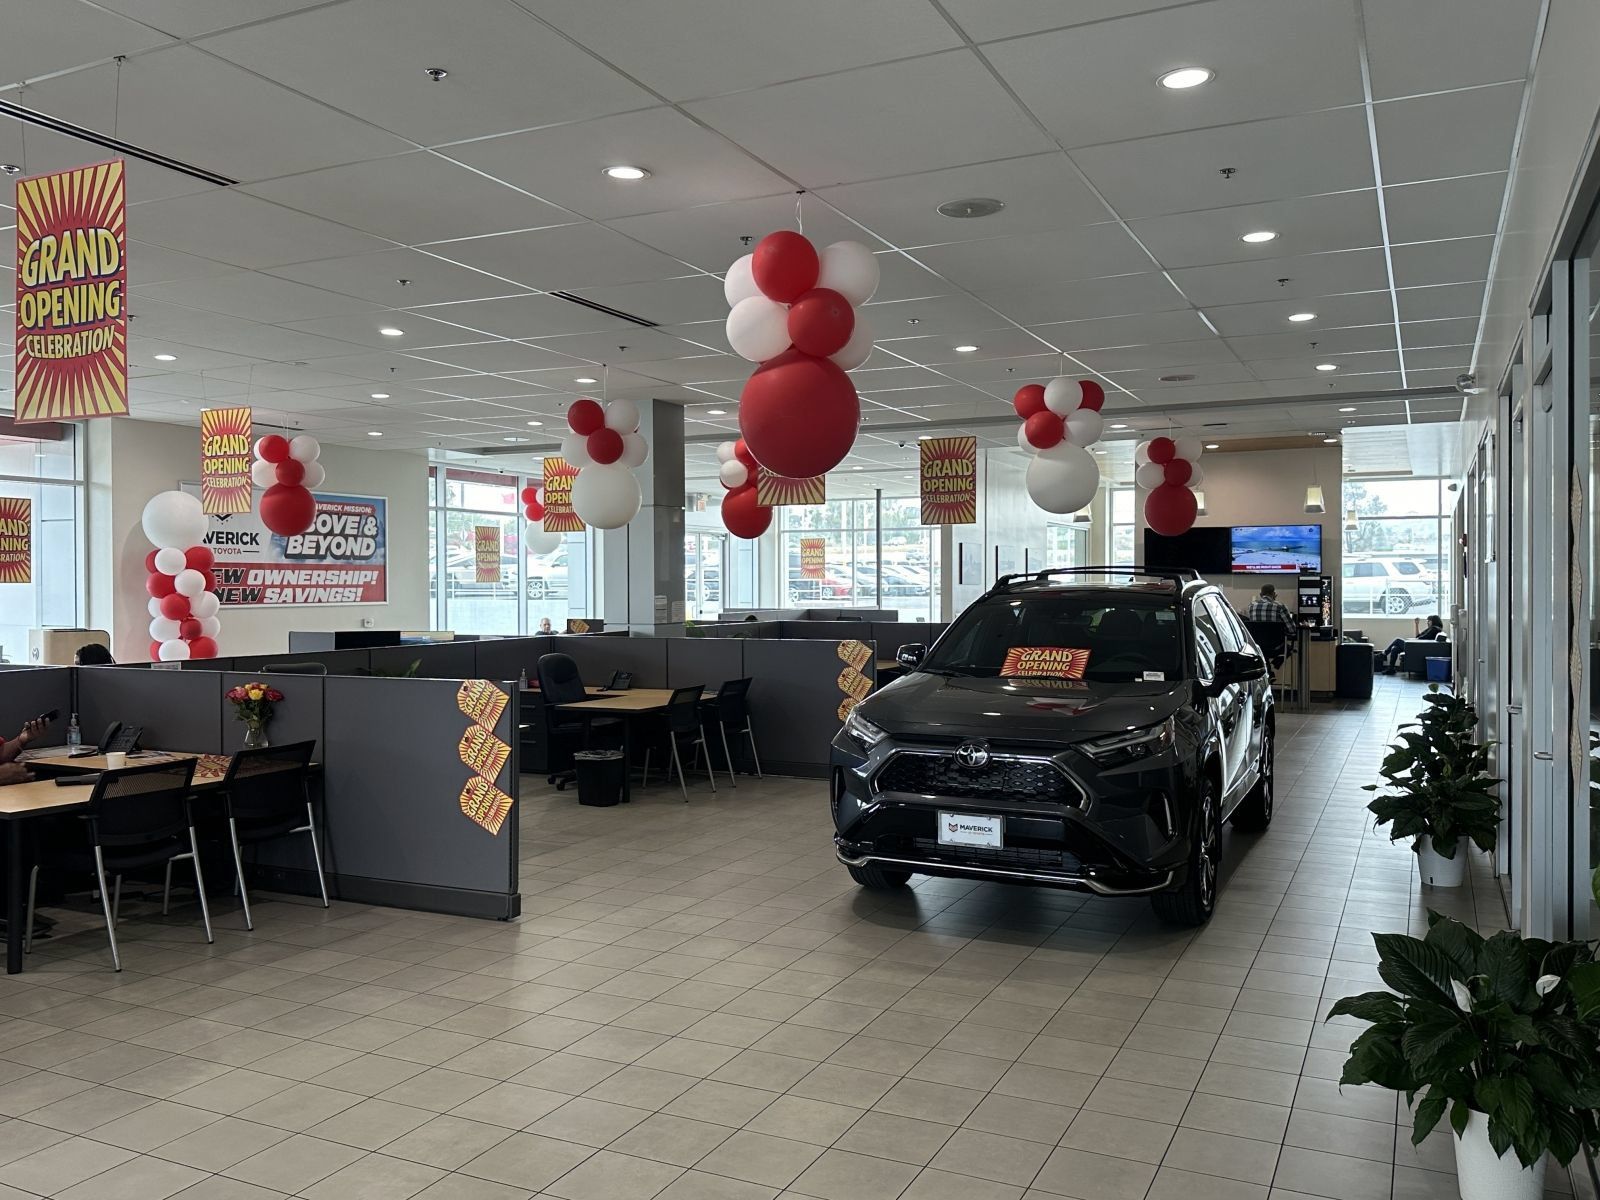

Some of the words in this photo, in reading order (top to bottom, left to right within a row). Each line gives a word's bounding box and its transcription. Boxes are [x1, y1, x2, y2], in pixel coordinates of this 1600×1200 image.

[21, 228, 120, 287] GRAND
[20, 280, 121, 329] OPENING
[25, 325, 115, 359] CELEBRATION
[204, 434, 249, 457] GRAND
[203, 457, 249, 475] OPENING
[923, 458, 974, 478] GRAND
[206, 476, 247, 489] CELEBRATION
[546, 475, 576, 491] GRAN
[922, 477, 974, 493] OPENING
[545, 492, 573, 504] OPENI
[925, 492, 972, 504] CELEBRATION
[0, 518, 29, 537] AND
[306, 513, 361, 535] OVE
[363, 516, 378, 536] &
[0, 537, 29, 551] NING
[202, 531, 260, 546] VERICK
[286, 534, 377, 557] BEYOND
[0, 552, 26, 563] RATION
[213, 547, 242, 555] TOYOTA
[211, 568, 246, 585] EW
[246, 569, 379, 586] OWNERSHIP!
[263, 587, 364, 603] SAVINGS!
[1020, 650, 1073, 662] GRAND
[1016, 661, 1071, 671] OPENING
[464, 681, 486, 713] GRAND
[472, 683, 494, 719] OPENING
[466, 730, 487, 764] GRAND
[474, 734, 495, 770] OPENING
[467, 782, 489, 816] GRAND
[475, 786, 497, 822] OPENING
[960, 824, 993, 833] MAVERICK
